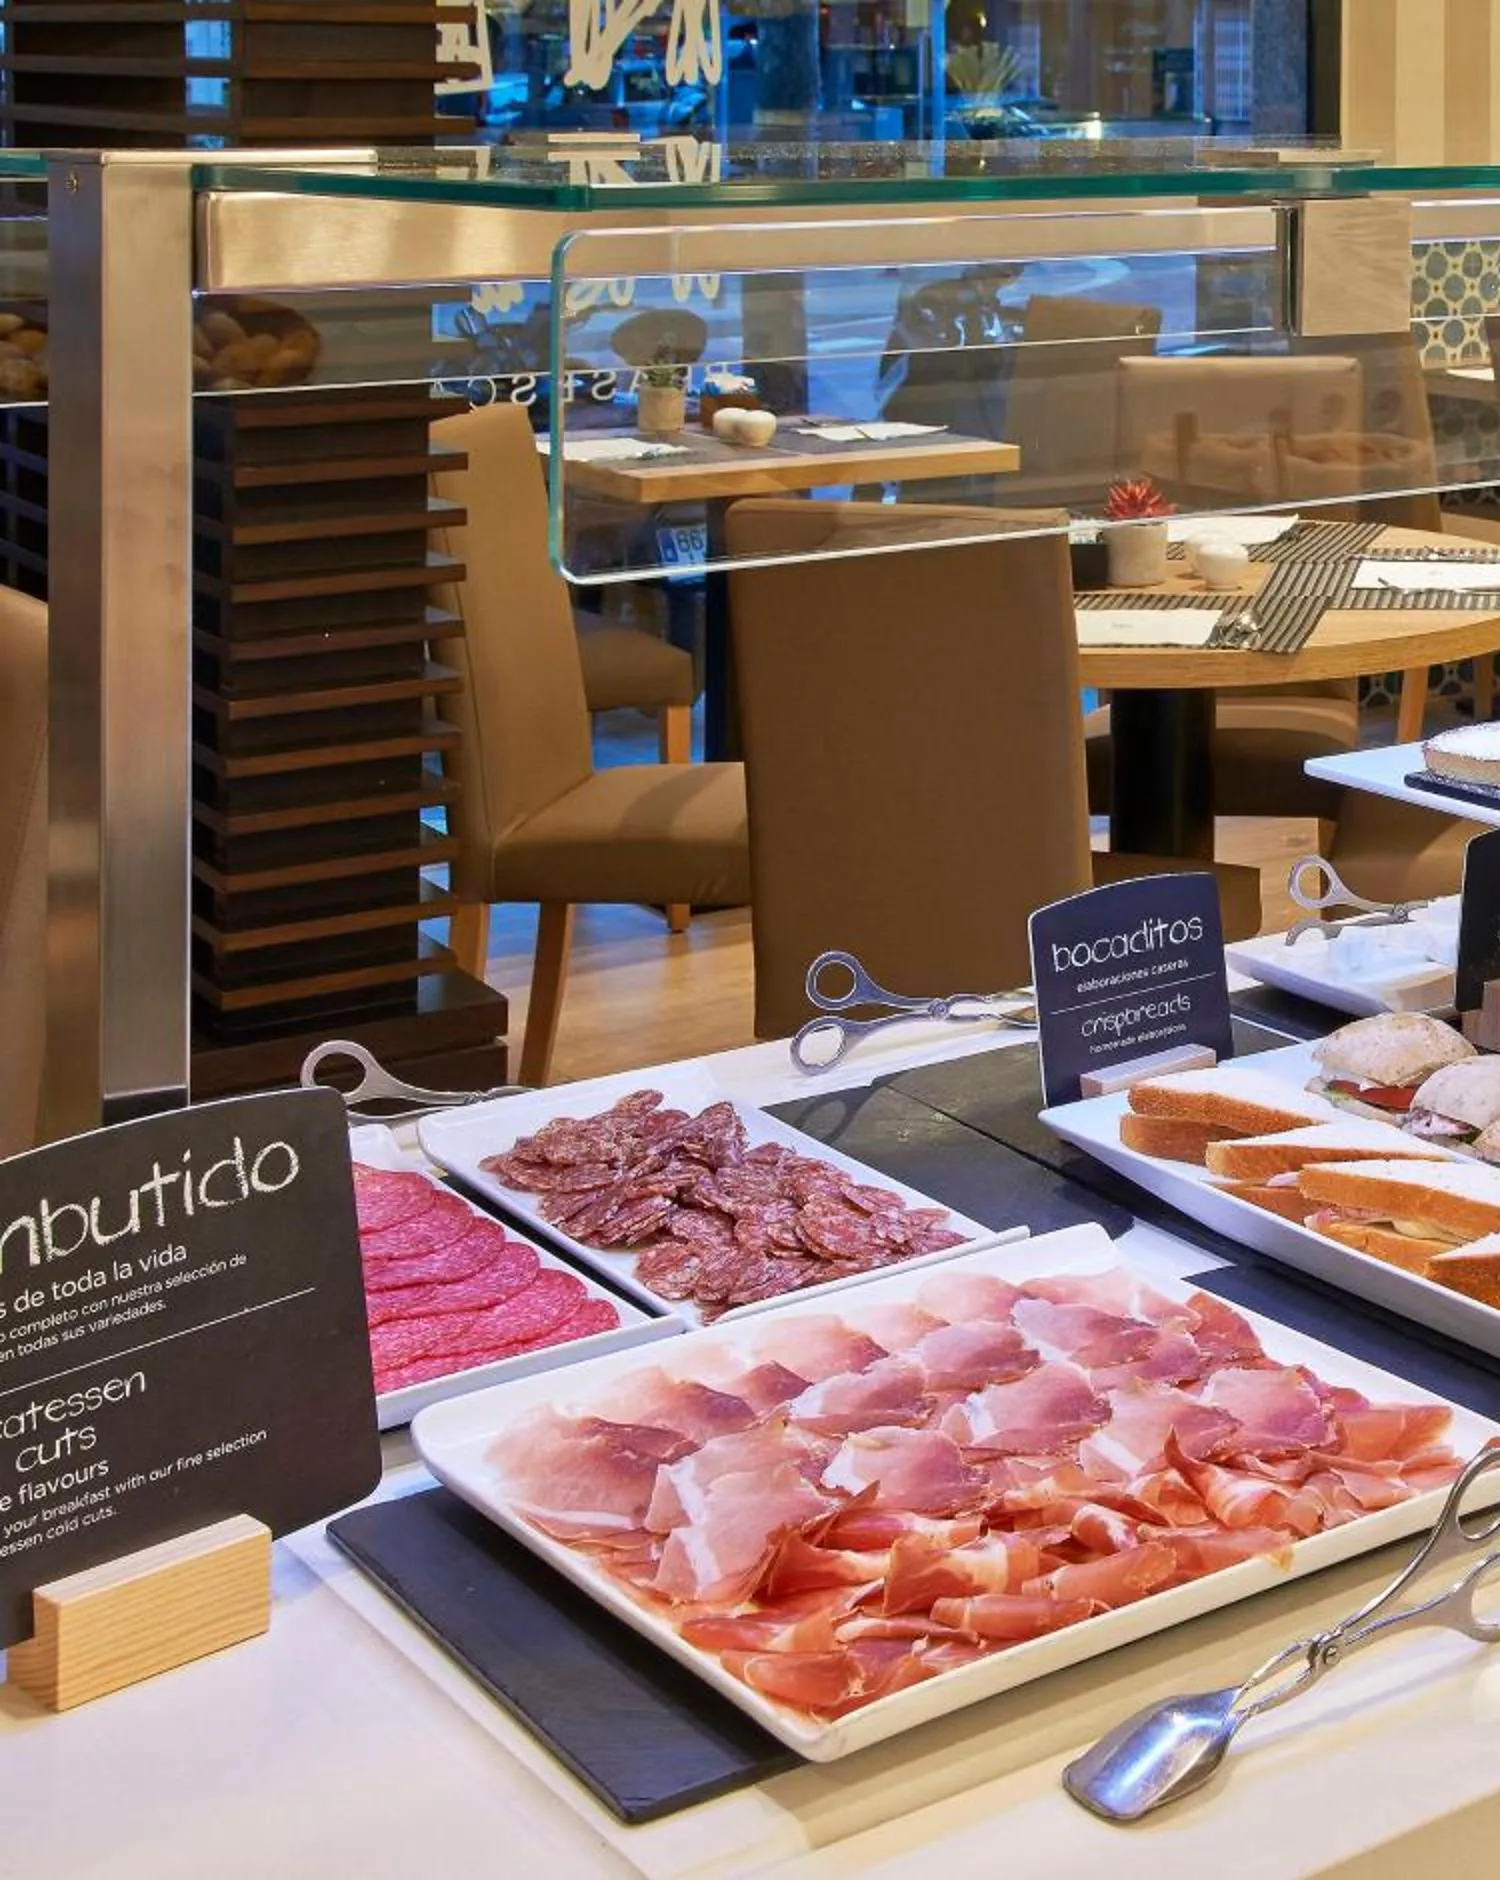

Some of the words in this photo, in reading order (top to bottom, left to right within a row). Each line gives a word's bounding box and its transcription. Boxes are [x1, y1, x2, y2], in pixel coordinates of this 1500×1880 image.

[1052, 916, 1203, 973] bocaditos
[1081, 993, 1192, 1037] crispbreads
[9, 1306, 79, 1339] completo
[81, 1298, 108, 1316] con
[111, 1281, 162, 1306] nuestra
[166, 1261, 227, 1289] selección
[229, 1253, 247, 1269] de
[14, 1289, 45, 1313] de
[51, 1270, 107, 1300] toda
[113, 1261, 133, 1281] la
[139, 1244, 187, 1273] vida
[18, 1333, 59, 1357] todas
[62, 1324, 85, 1342] sus
[0, 1371, 146, 1439] atessen
[15, 1426, 97, 1473] cuts
[4, 1514, 38, 1539] your
[42, 1486, 110, 1521] breakfast
[115, 1474, 146, 1495] with
[150, 1465, 173, 1482] our
[176, 1452, 203, 1472] fine
[206, 1428, 268, 1462] selection
[19, 1460, 109, 1505] flavours
[0, 1532, 43, 1557] essen
[46, 1519, 80, 1539] cold
